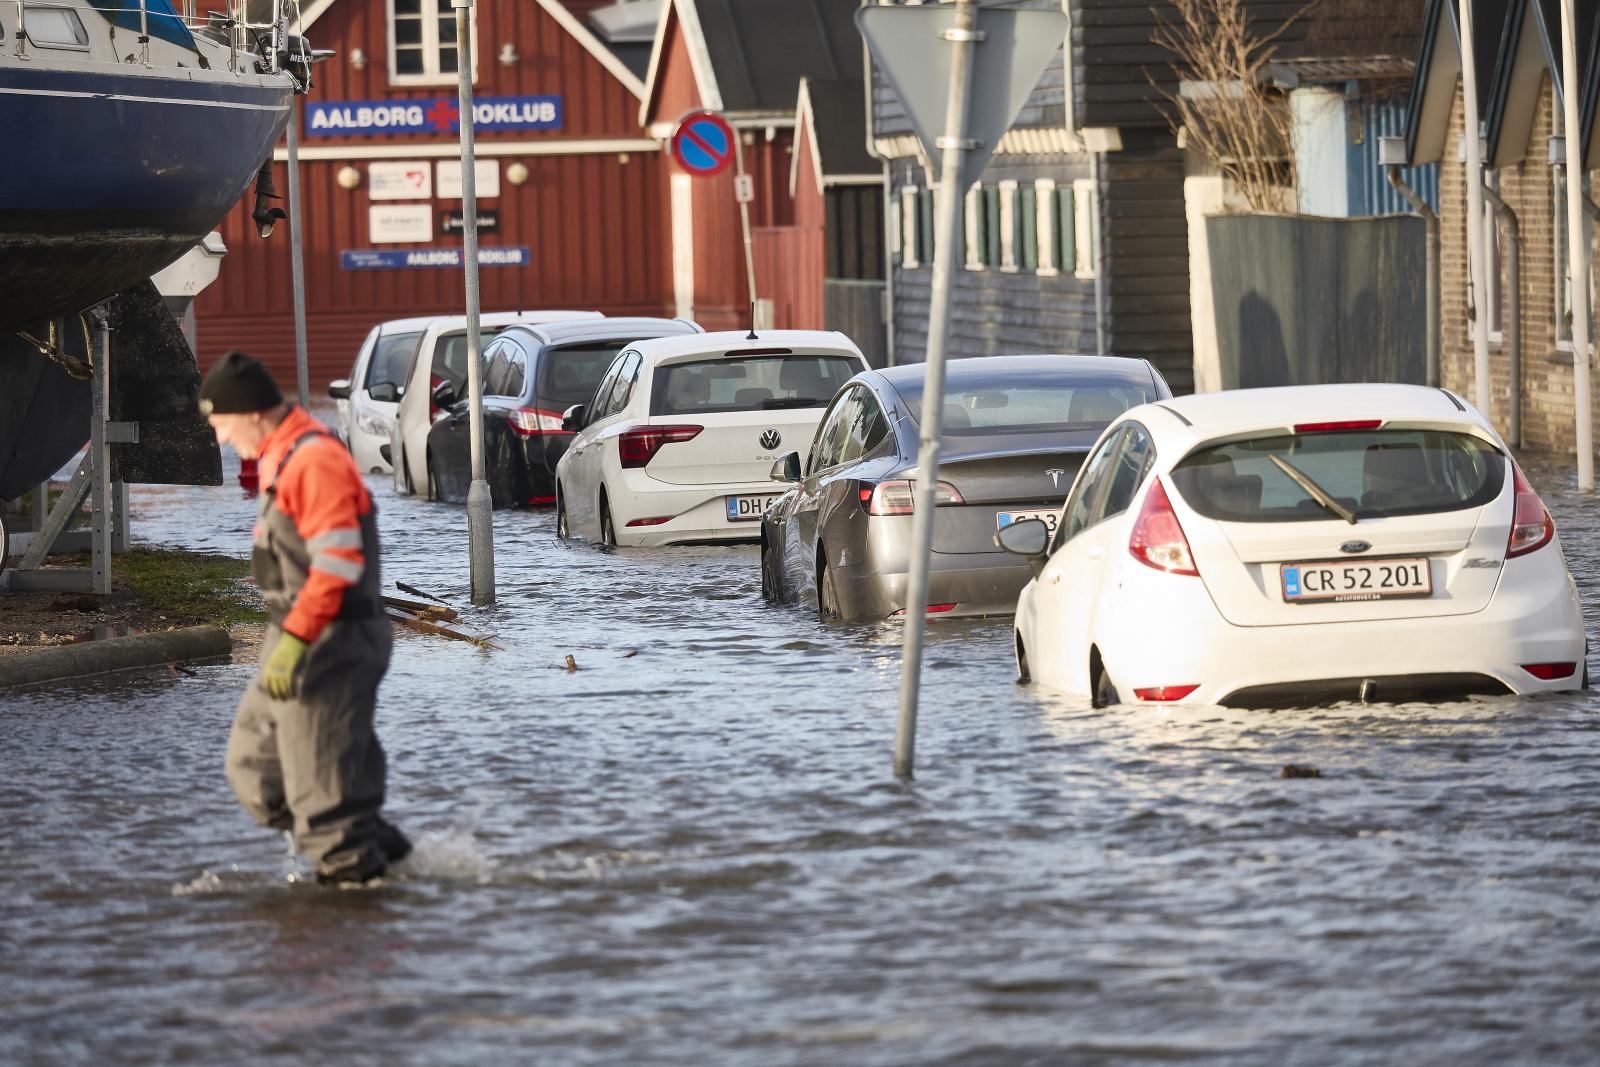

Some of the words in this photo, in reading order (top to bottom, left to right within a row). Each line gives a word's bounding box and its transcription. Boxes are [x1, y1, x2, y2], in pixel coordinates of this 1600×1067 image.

[311, 106, 424, 128] AALBORG
[739, 498, 762, 514] DH
[1286, 584, 1298, 592] DK
[1303, 570, 1336, 592] CR
[1343, 567, 1373, 589] 52
[1380, 565, 1424, 588] 201
